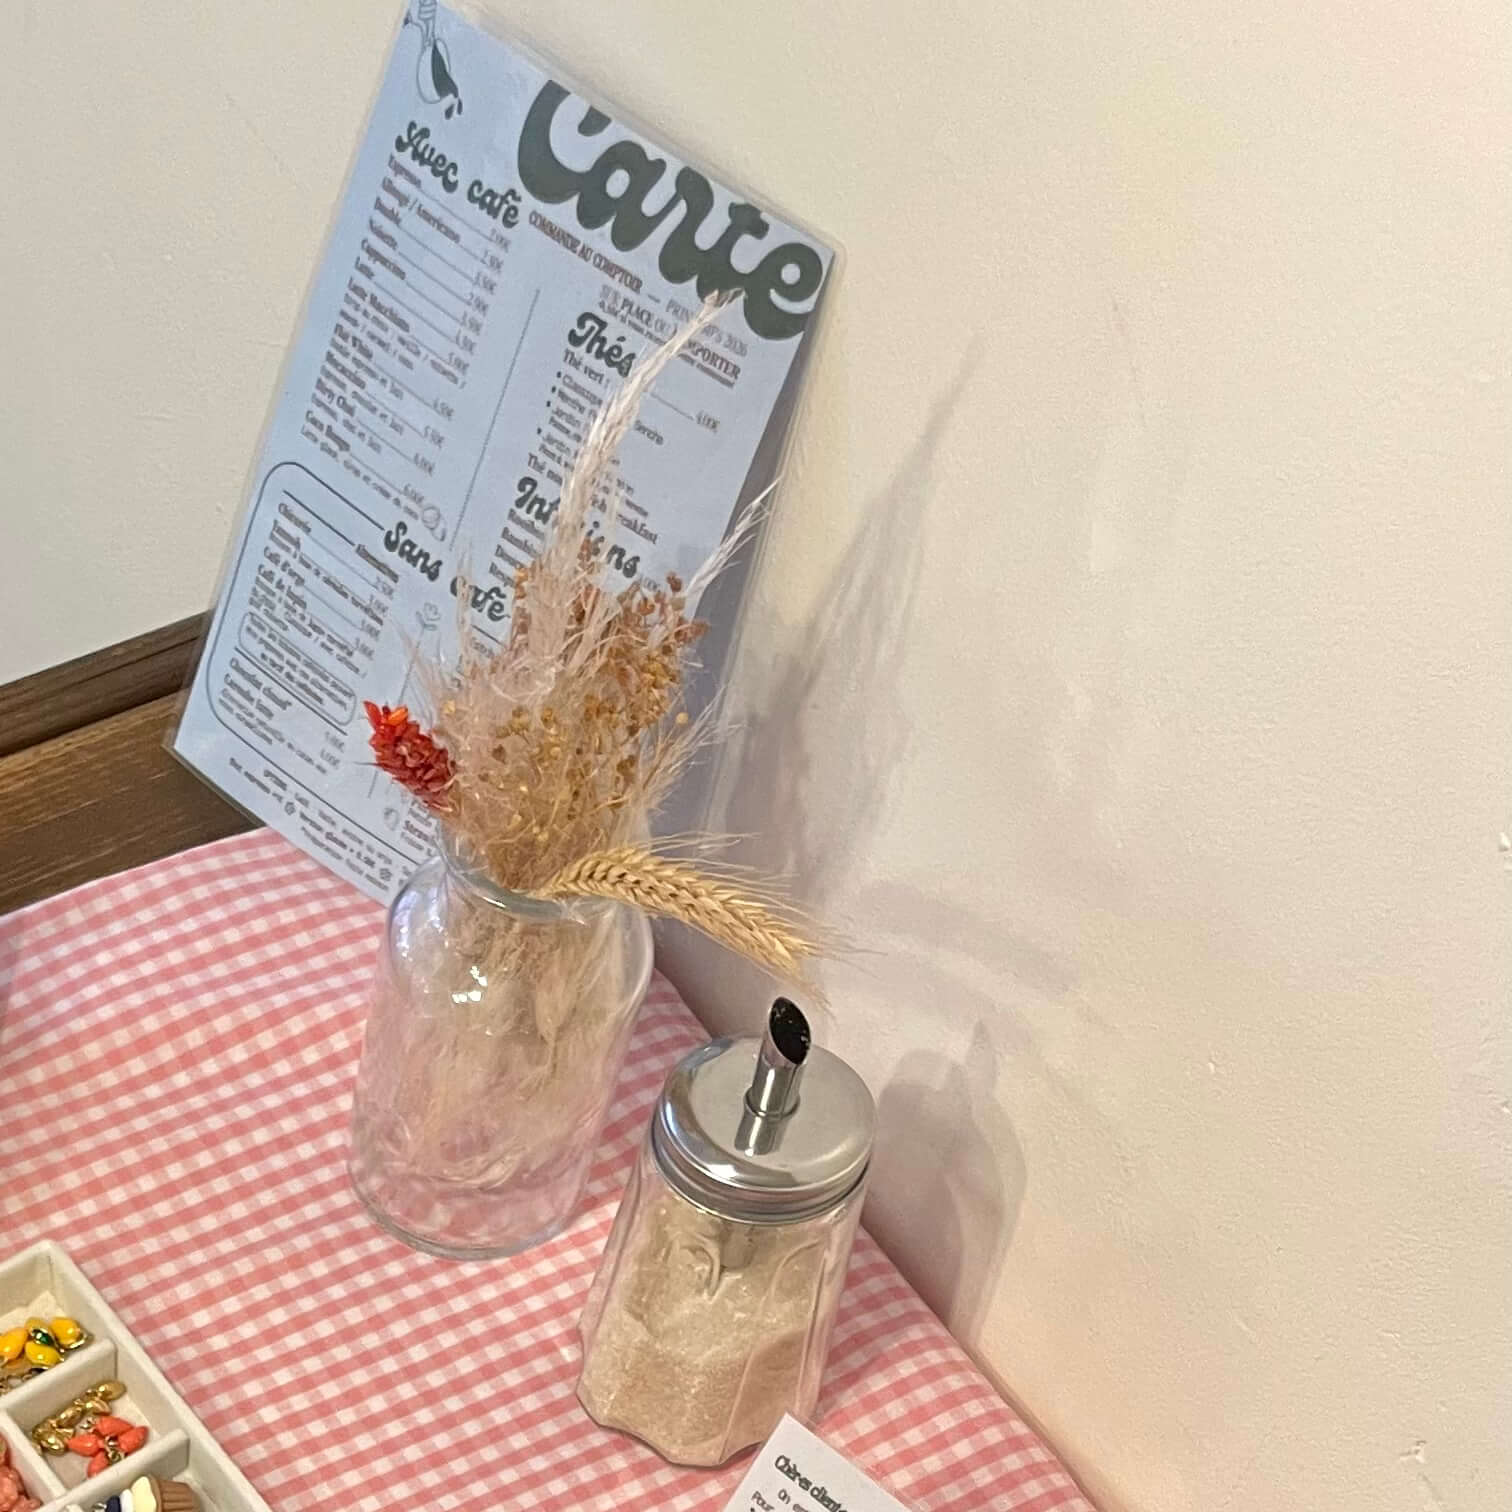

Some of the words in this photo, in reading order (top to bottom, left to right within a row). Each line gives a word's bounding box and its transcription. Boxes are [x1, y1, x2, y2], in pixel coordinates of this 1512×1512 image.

[395, 120, 459, 193] Avec
[467, 178, 522, 229] café
[517, 79, 824, 342] Carte
[567, 312, 637, 378] Thés
[619, 297, 654, 328] PLACE
[384, 520, 443, 582] Sans
